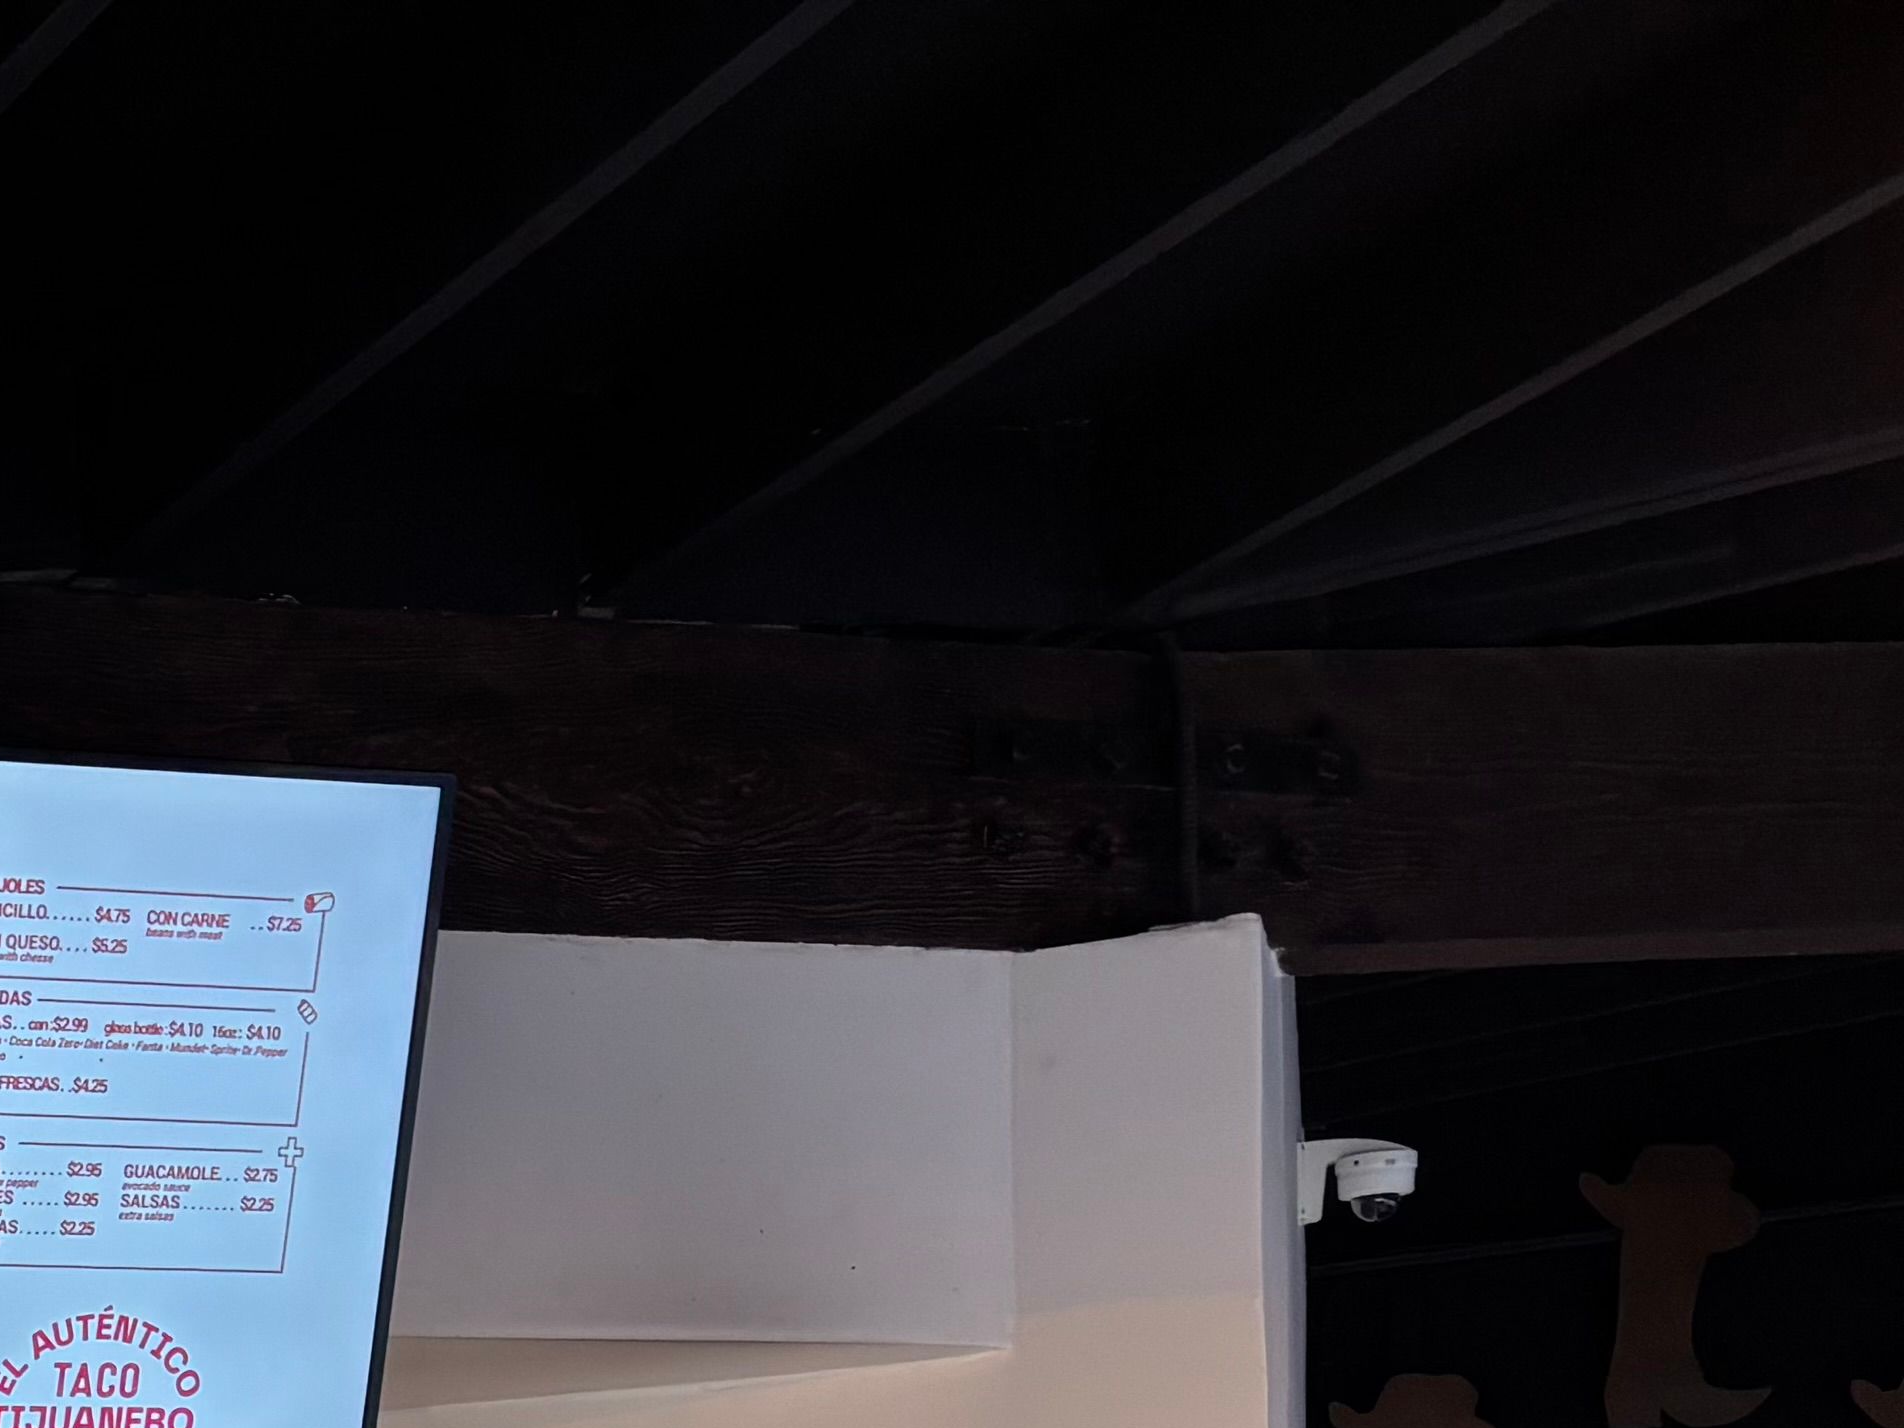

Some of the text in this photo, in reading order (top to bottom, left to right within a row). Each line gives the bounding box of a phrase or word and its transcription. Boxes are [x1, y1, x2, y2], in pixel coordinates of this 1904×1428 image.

[147, 910, 178, 927] CON
[181, 912, 230, 929] CARNE
[124, 1165, 220, 1181] GUACAMOLE
[32, 1305, 200, 1398] AUTÉNTICO
[54, 1362, 140, 1398] TACO
